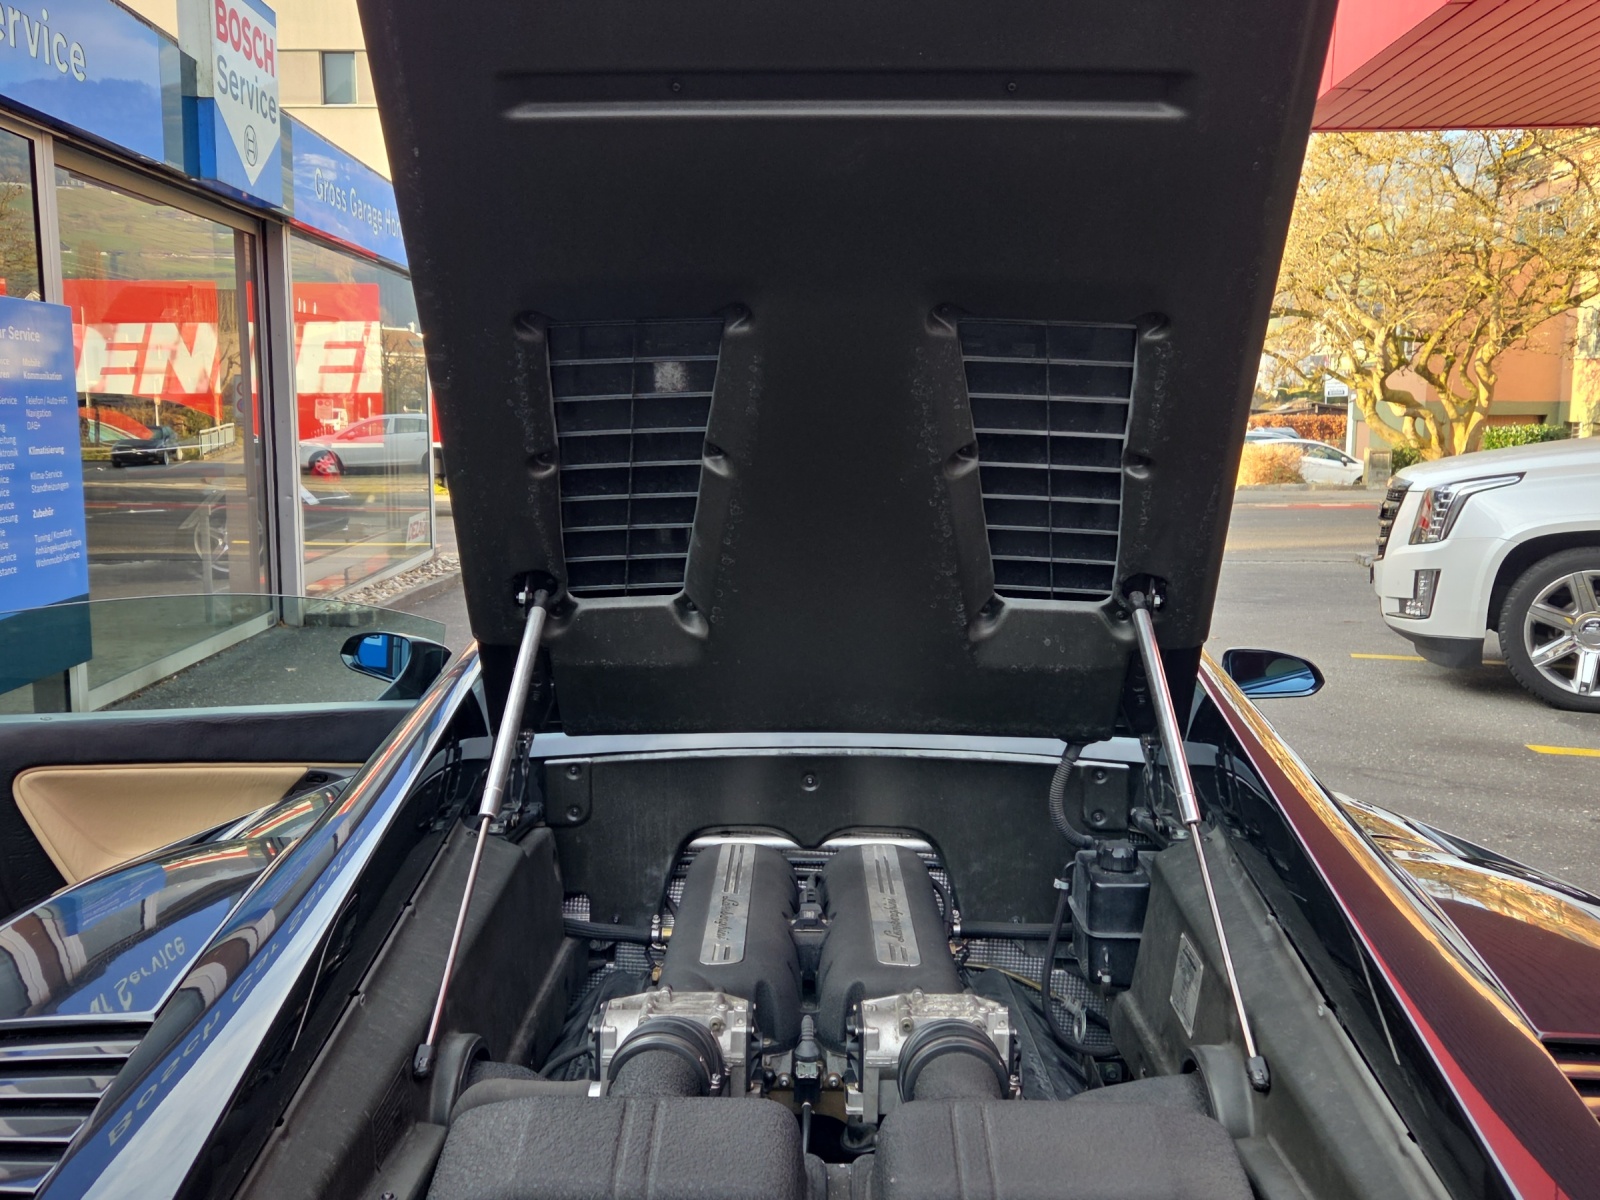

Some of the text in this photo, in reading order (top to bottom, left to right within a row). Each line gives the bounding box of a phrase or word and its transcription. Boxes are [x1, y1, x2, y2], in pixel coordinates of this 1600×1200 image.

[214, 0, 274, 78] BOSCH
[217, 55, 276, 124] Service
[315, 168, 346, 212] Gross
[350, 187, 383, 235] Garage
[8, 325, 40, 342] Service
[23, 371, 62, 380] Kommunikation
[25, 395, 43, 404] Telefon
[26, 409, 52, 419] Navigation
[29, 446, 64, 455] Klimatisierung
[33, 507, 54, 519] Zubehör
